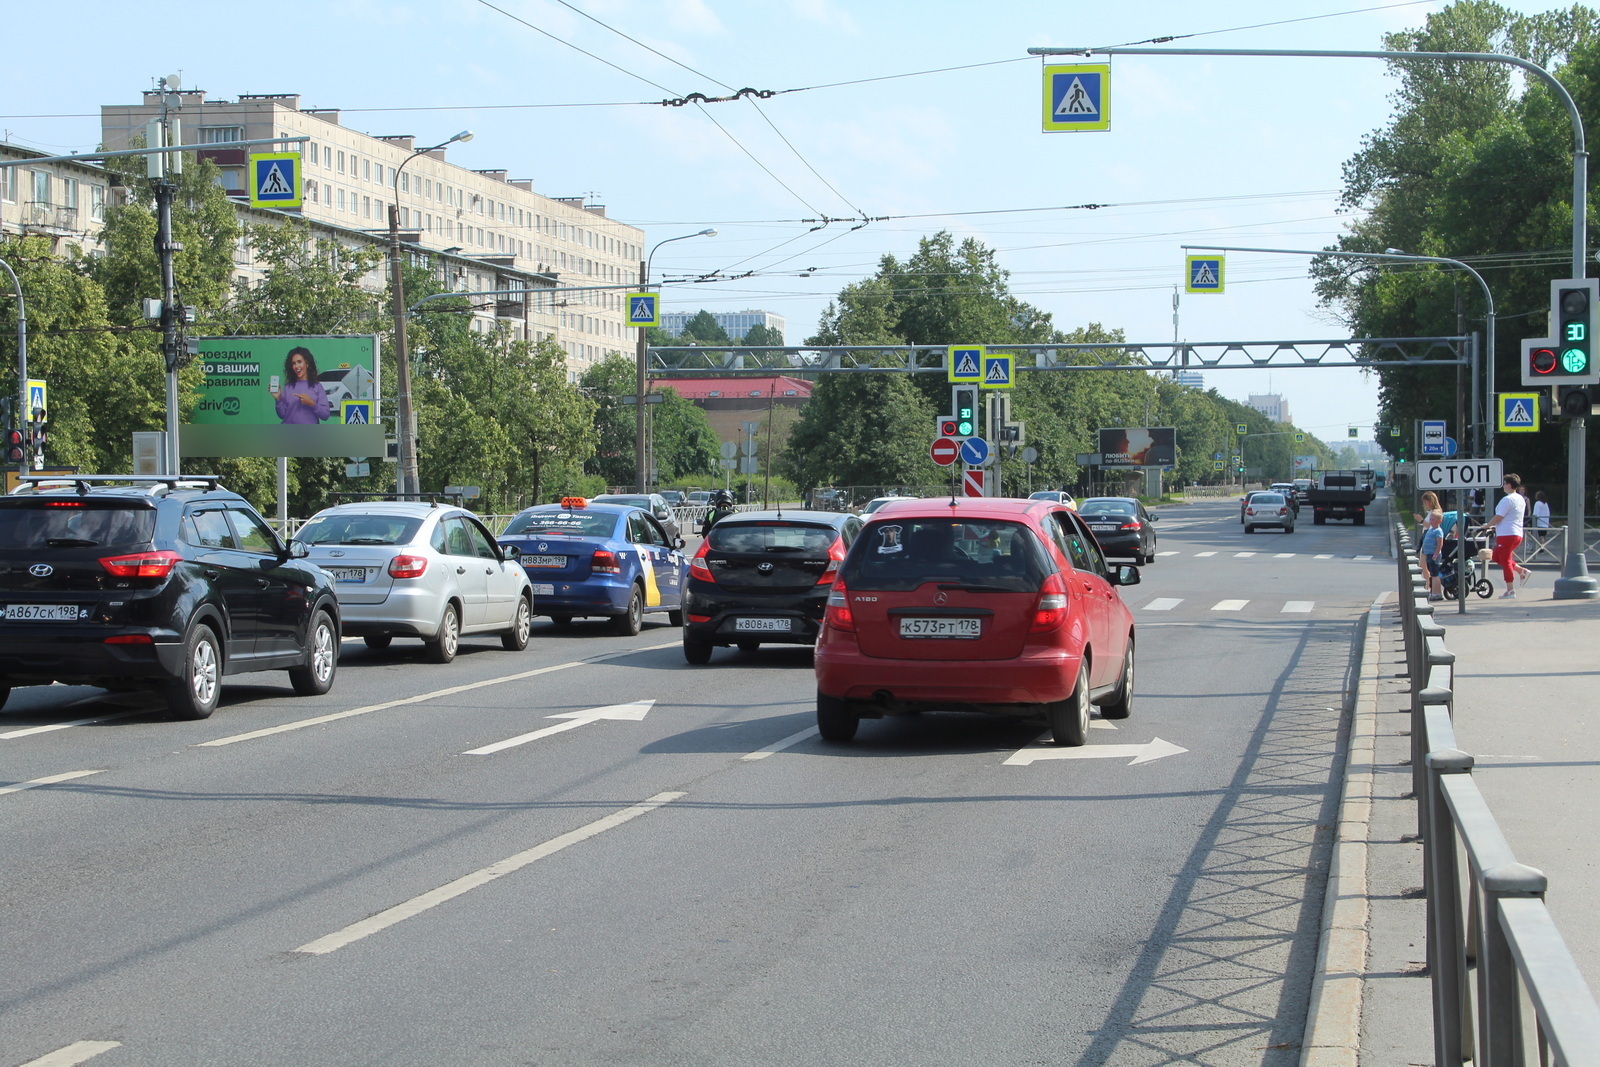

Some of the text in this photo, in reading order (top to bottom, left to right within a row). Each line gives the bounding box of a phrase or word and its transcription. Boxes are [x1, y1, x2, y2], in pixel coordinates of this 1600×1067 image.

[1567, 323, 1585, 341] 30
[217, 364, 259, 373] вашим
[199, 398, 240, 414] drivee
[961, 408, 971, 418] 30
[1429, 465, 1490, 484] СТОП
[958, 620, 977, 630] 178
